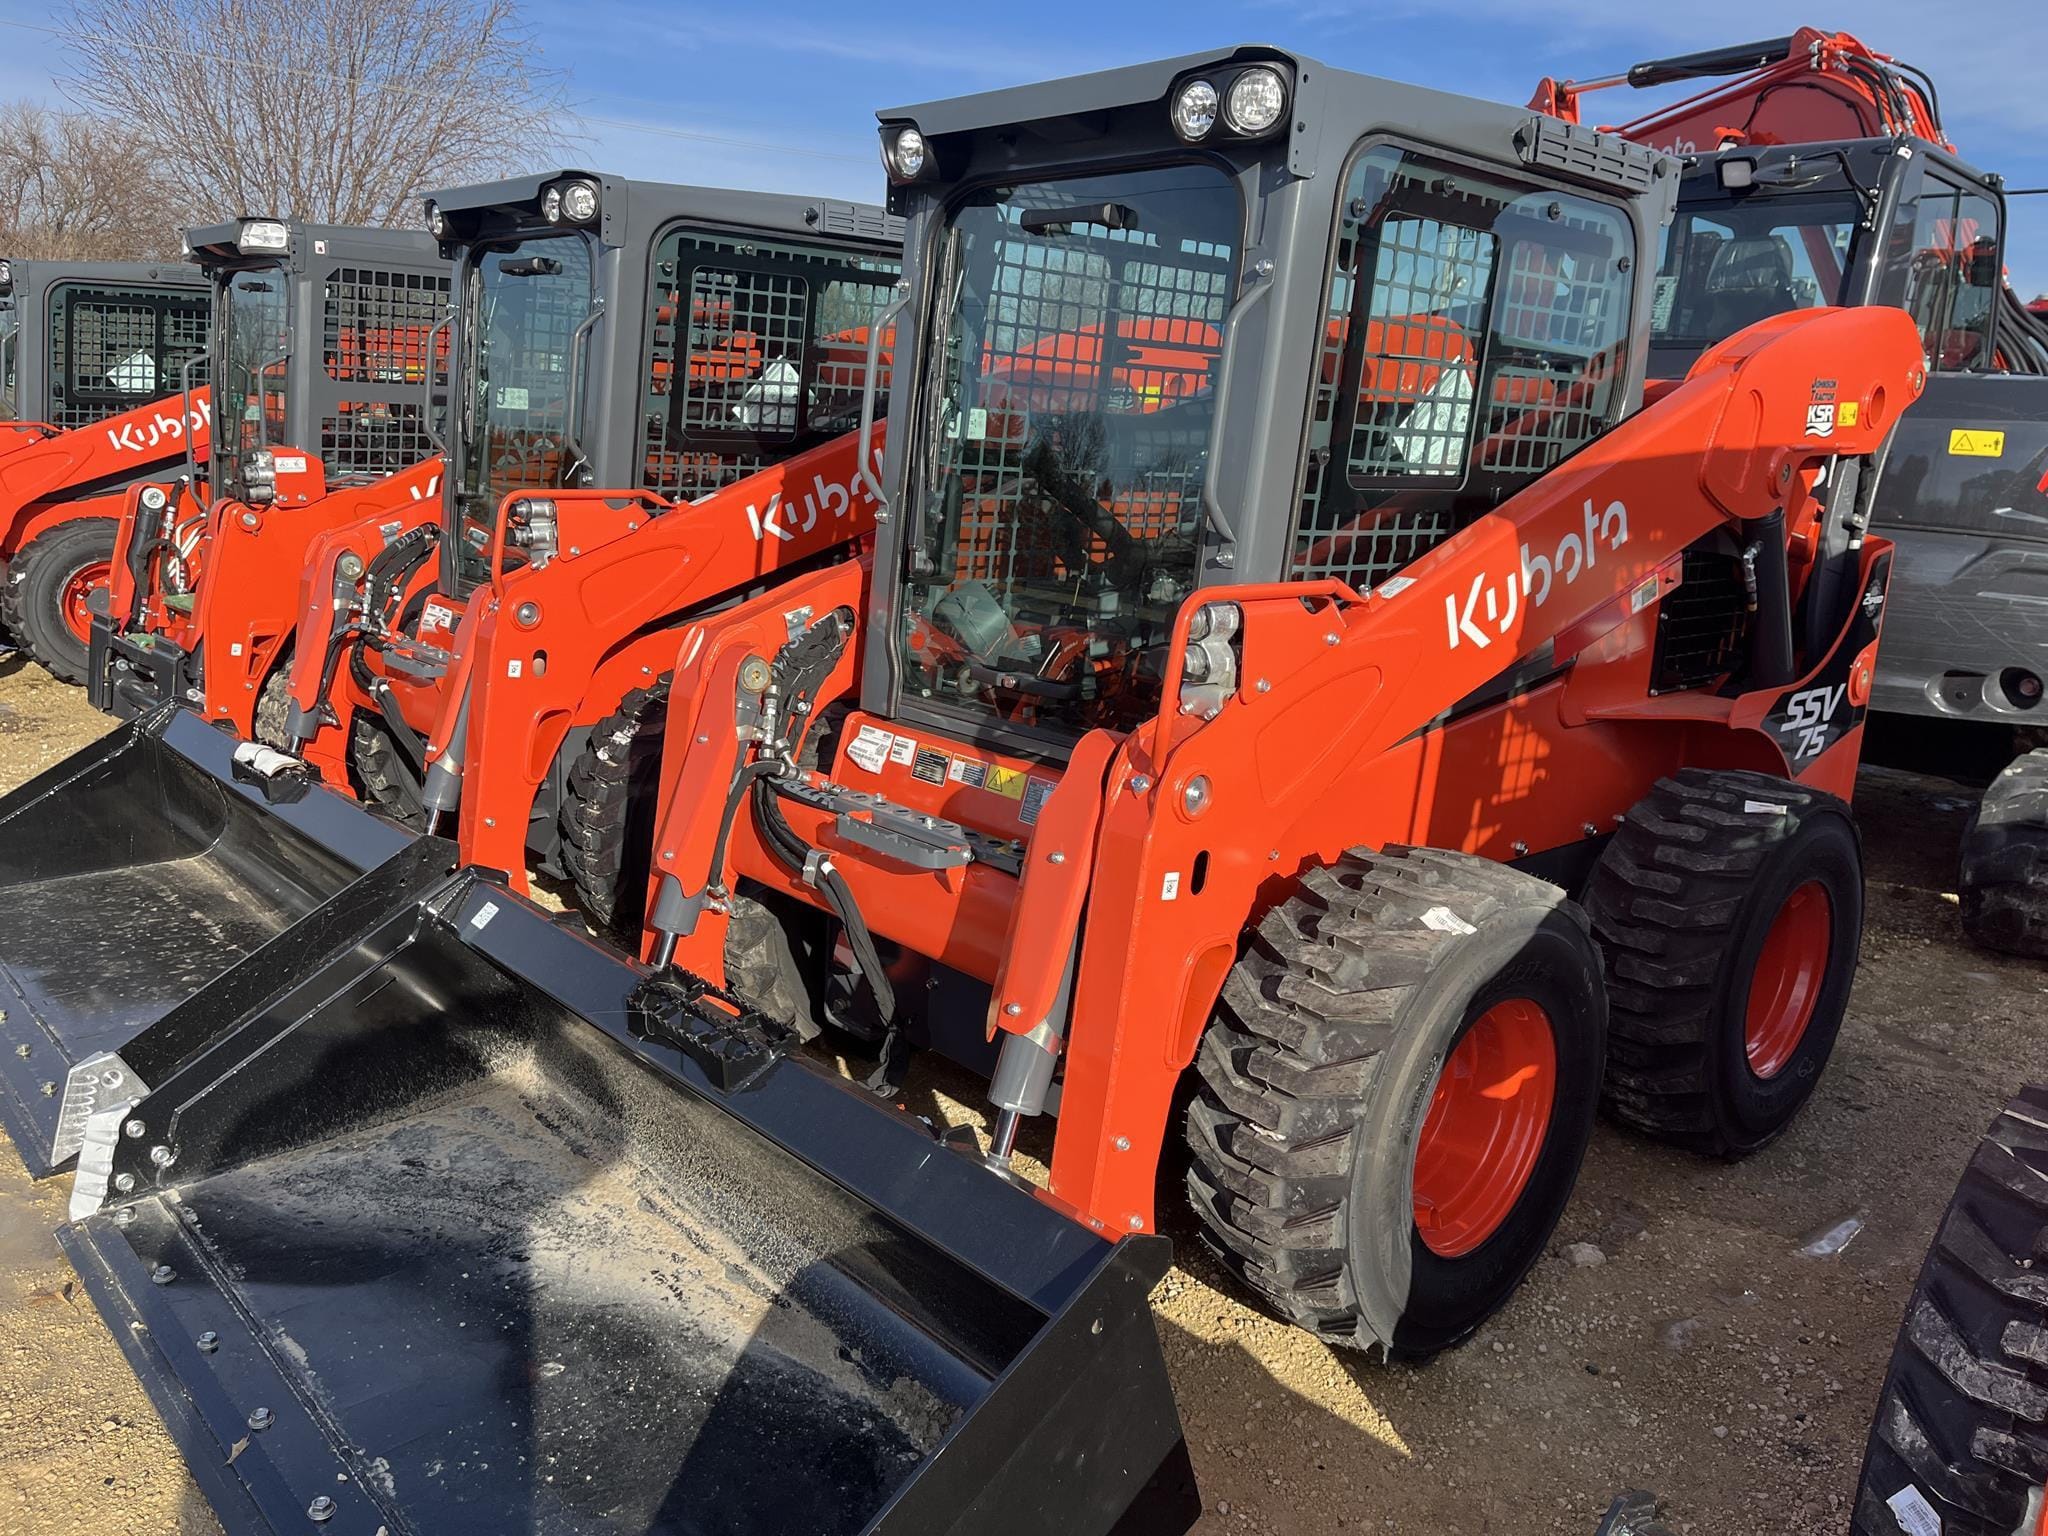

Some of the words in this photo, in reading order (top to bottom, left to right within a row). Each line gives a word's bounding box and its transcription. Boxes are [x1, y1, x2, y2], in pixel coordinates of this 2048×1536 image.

[107, 399, 211, 451] Kubot
[1807, 404, 1835, 423] KSR
[1445, 499, 1628, 650] Kubota
[1780, 683, 1847, 732] SSV
[1794, 723, 1829, 760] 75
